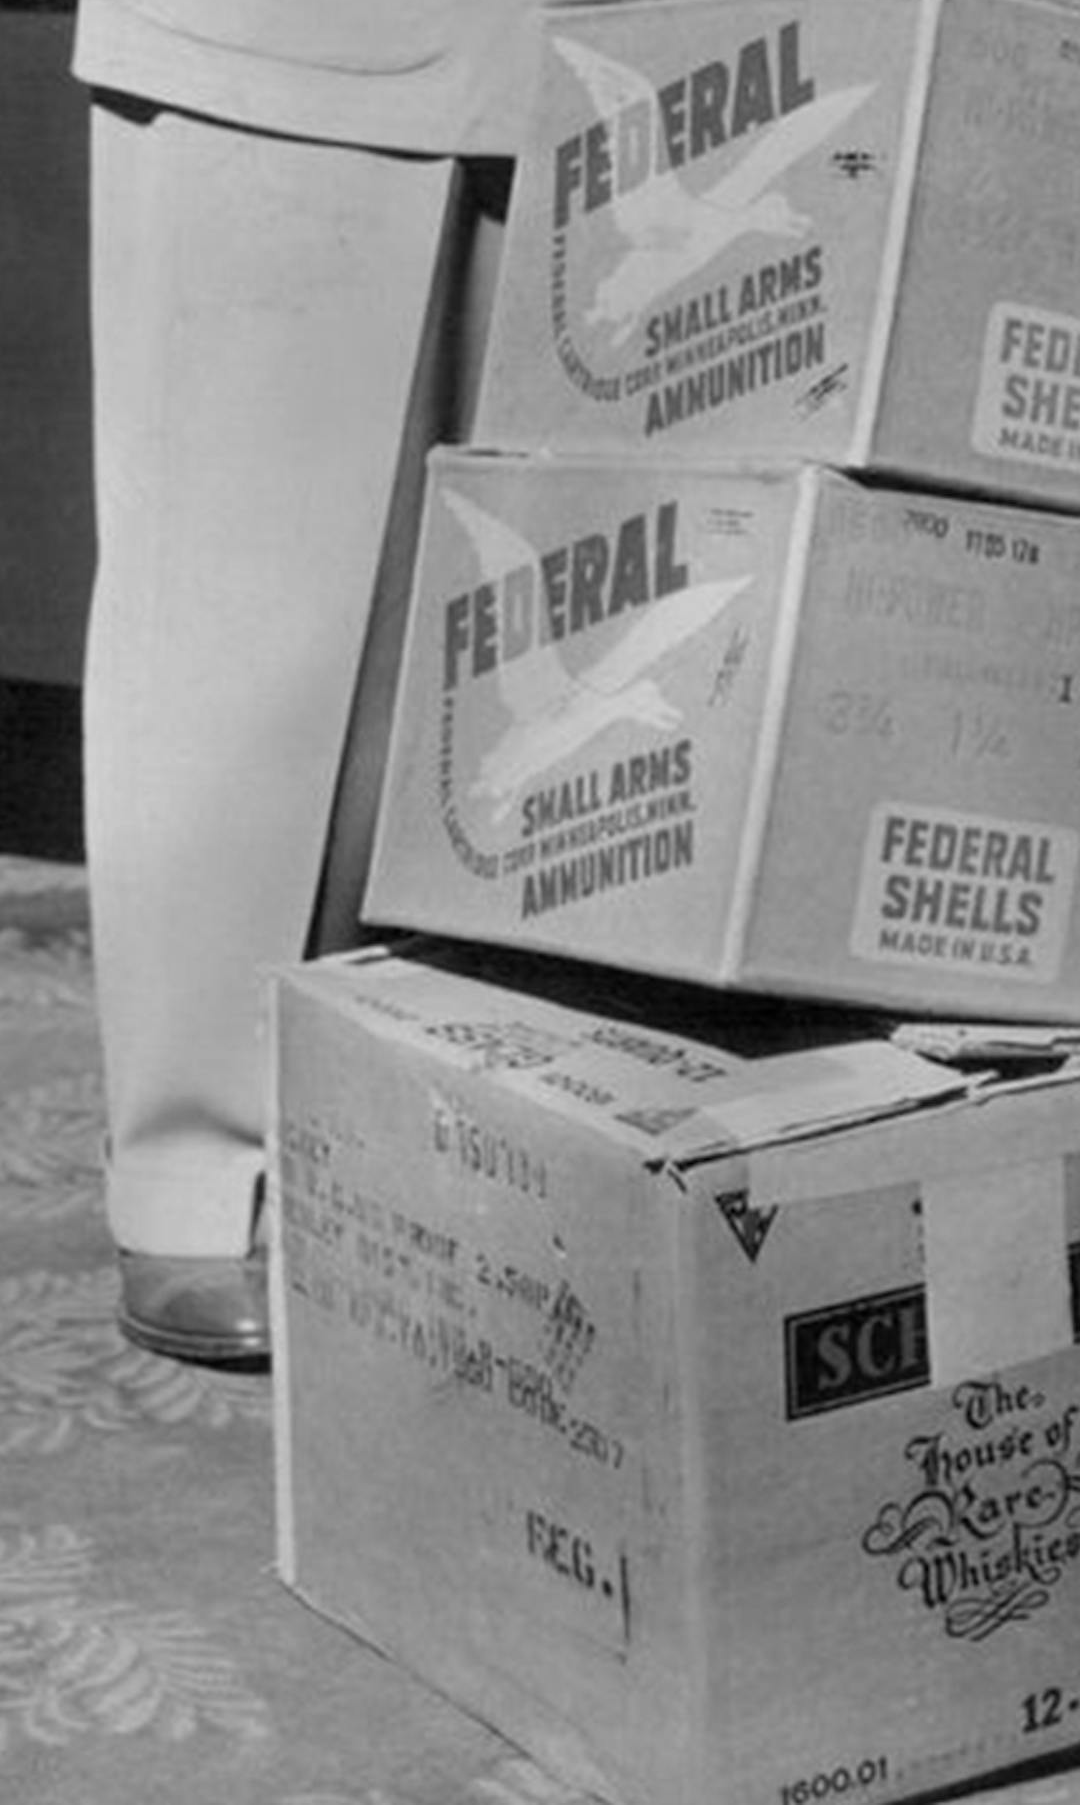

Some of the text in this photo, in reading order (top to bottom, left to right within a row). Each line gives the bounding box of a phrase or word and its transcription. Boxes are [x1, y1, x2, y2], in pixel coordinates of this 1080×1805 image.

[552, 19, 816, 231] FEDERAL
[644, 284, 733, 360] SMALL
[736, 244, 824, 317] ARMS
[644, 322, 826, 439] AMMUNITION
[998, 426, 1064, 460] MADE
[443, 499, 690, 693] FEDERAL
[521, 738, 694, 840] SMALL ARMS
[520, 819, 695, 921] AMMUNITION
[880, 815, 1056, 886] FEDERAL
[878, 928, 947, 959] MADE
[951, 934, 976, 961] IN
[880, 874, 1044, 938] SHELLS
[904, 1404, 1080, 1487] House of
[952, 1380, 1030, 1431] The
